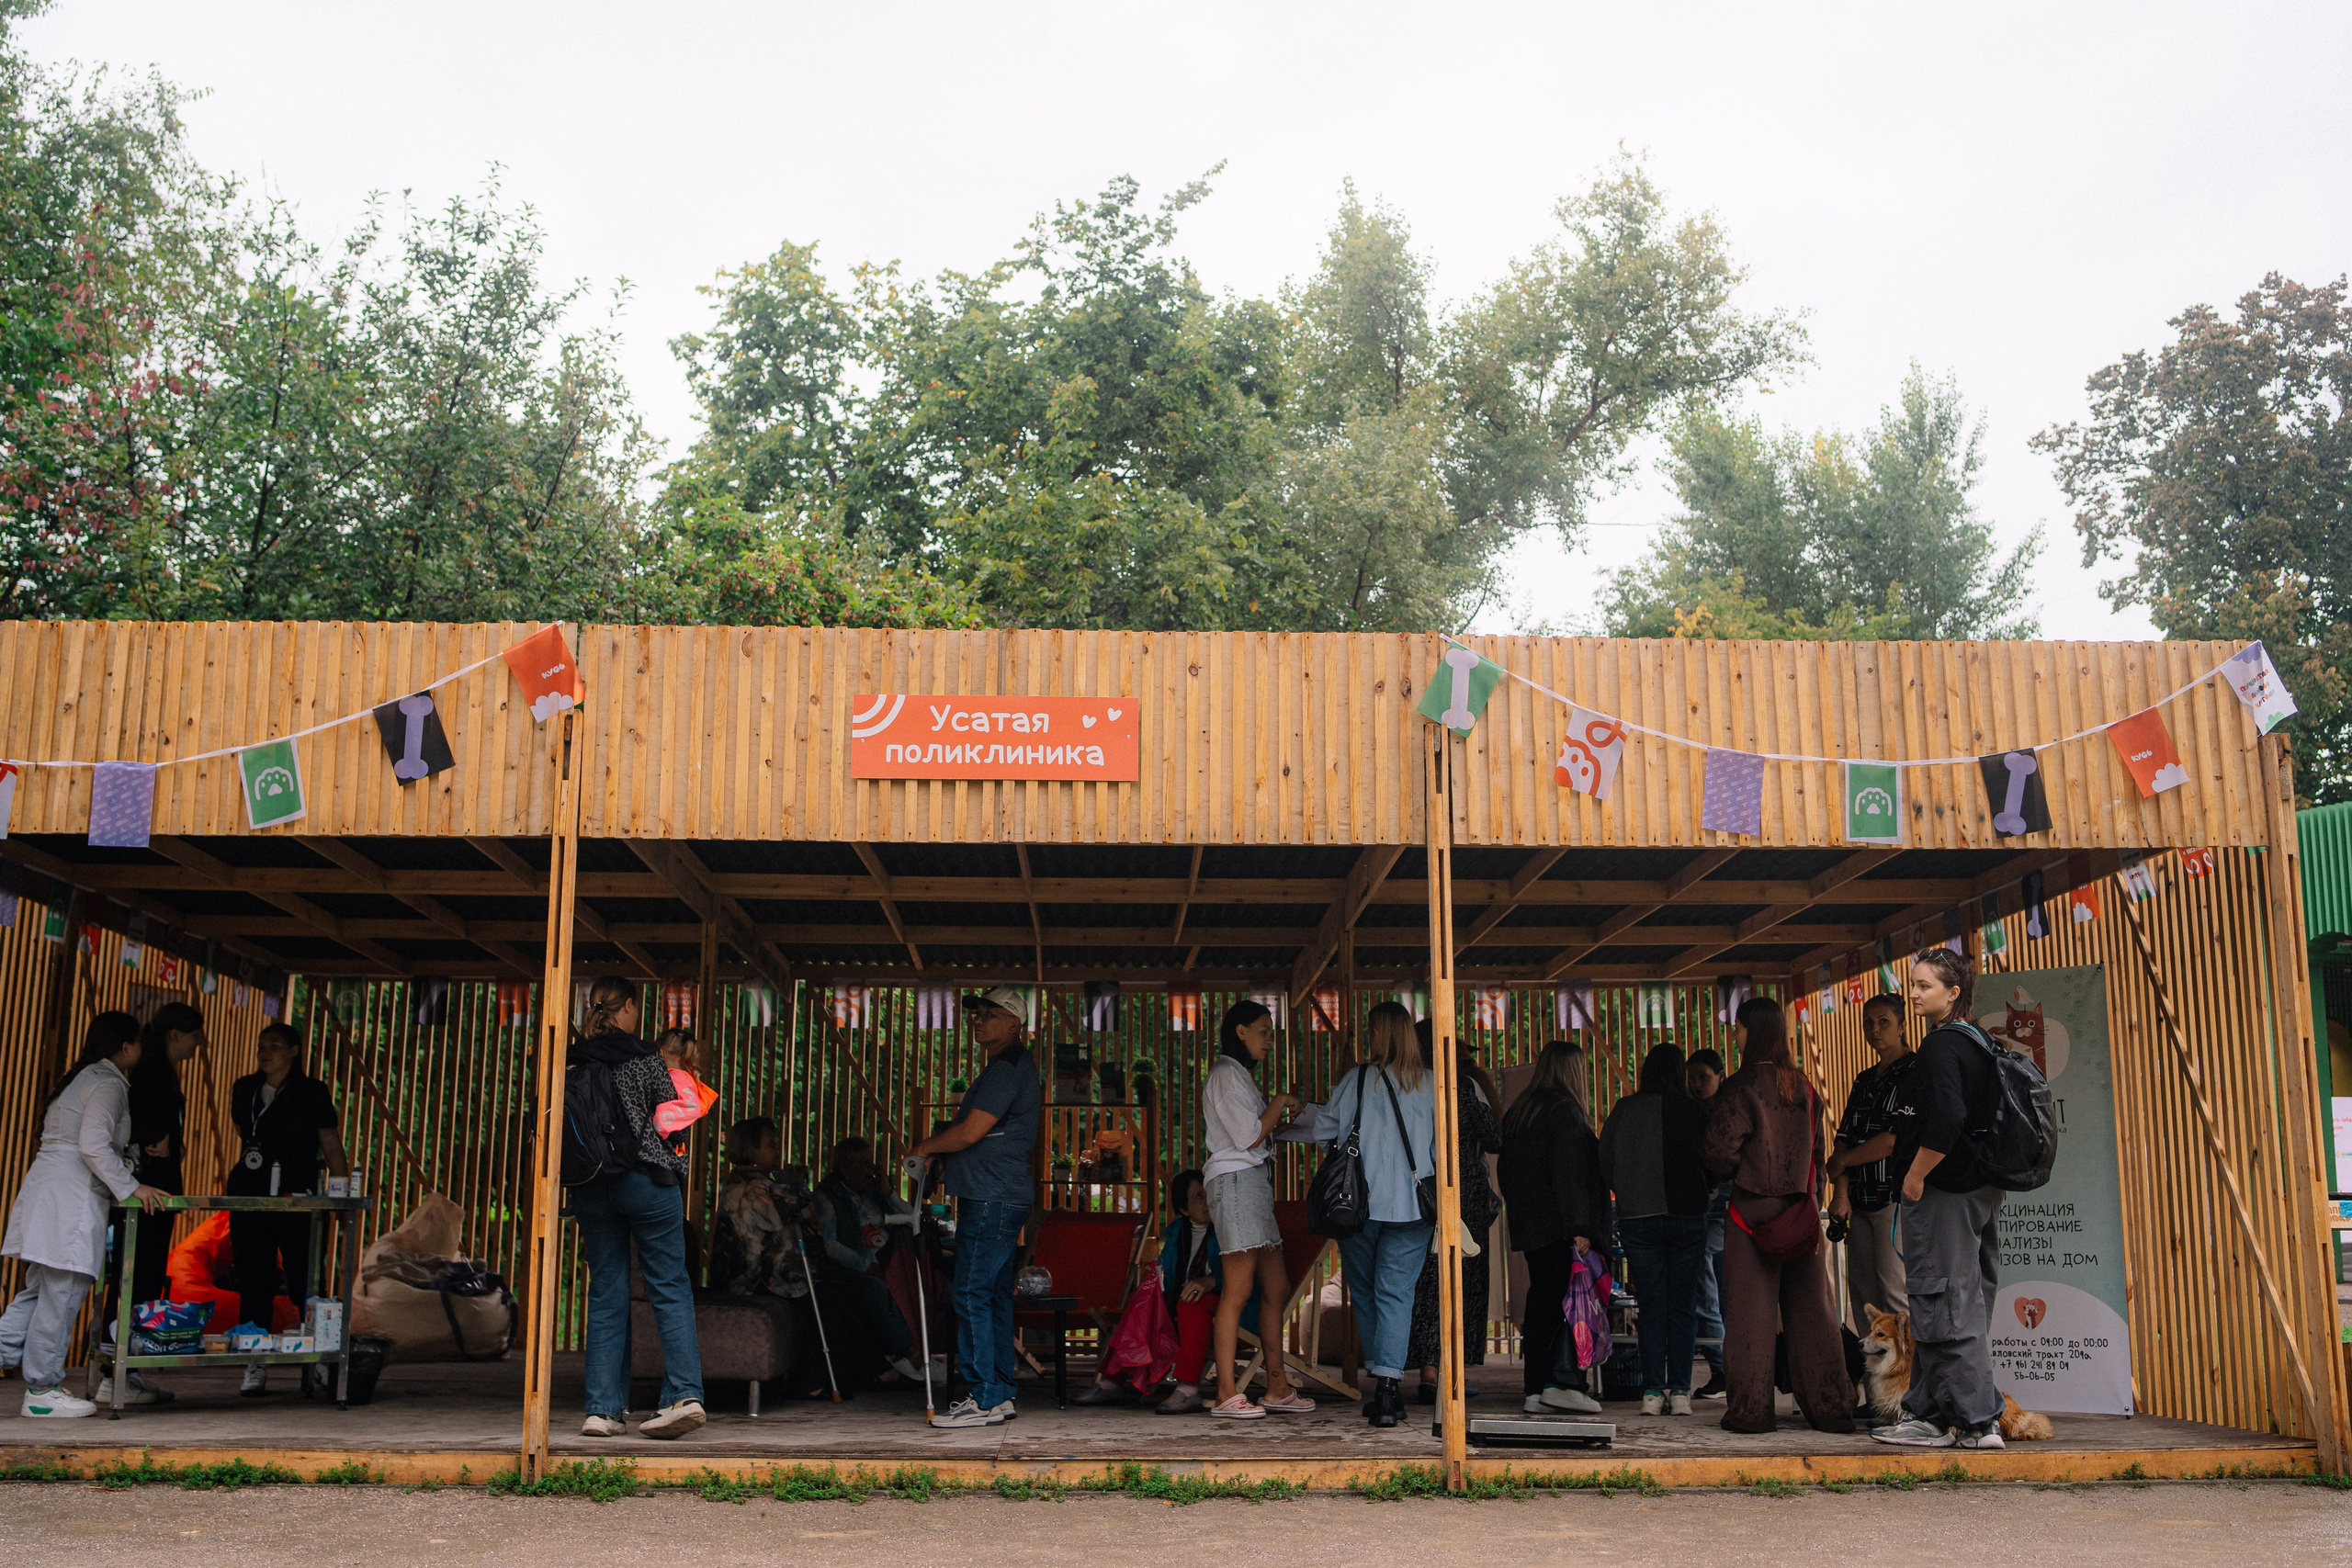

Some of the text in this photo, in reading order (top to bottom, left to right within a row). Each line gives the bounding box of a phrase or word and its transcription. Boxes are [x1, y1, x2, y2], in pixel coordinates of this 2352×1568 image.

[929, 704, 1050, 733] Усатая
[885, 742, 1105, 766] поликлиника
[1999, 1203, 2075, 1219] КЦИНАЦИЯ
[1998, 1220, 2083, 1233] ПИРОВАНИЕ
[1998, 1236, 2052, 1250] АЛИЗЫ
[1999, 1253, 2098, 1269] ЗОВ НА ДОМ
[1992, 1337, 2028, 1348] работы
[2041, 1337, 2064, 1348] 09:00
[2067, 1340, 2080, 1348] до
[2083, 1337, 2109, 1348] 00:00
[1991, 1348, 2032, 1359] вловский
[2036, 1350, 2064, 1360] тракт
[2000, 1359, 2069, 1371] +7 961 241 89 09
[2014, 1371, 2055, 1382] 56-06-05
